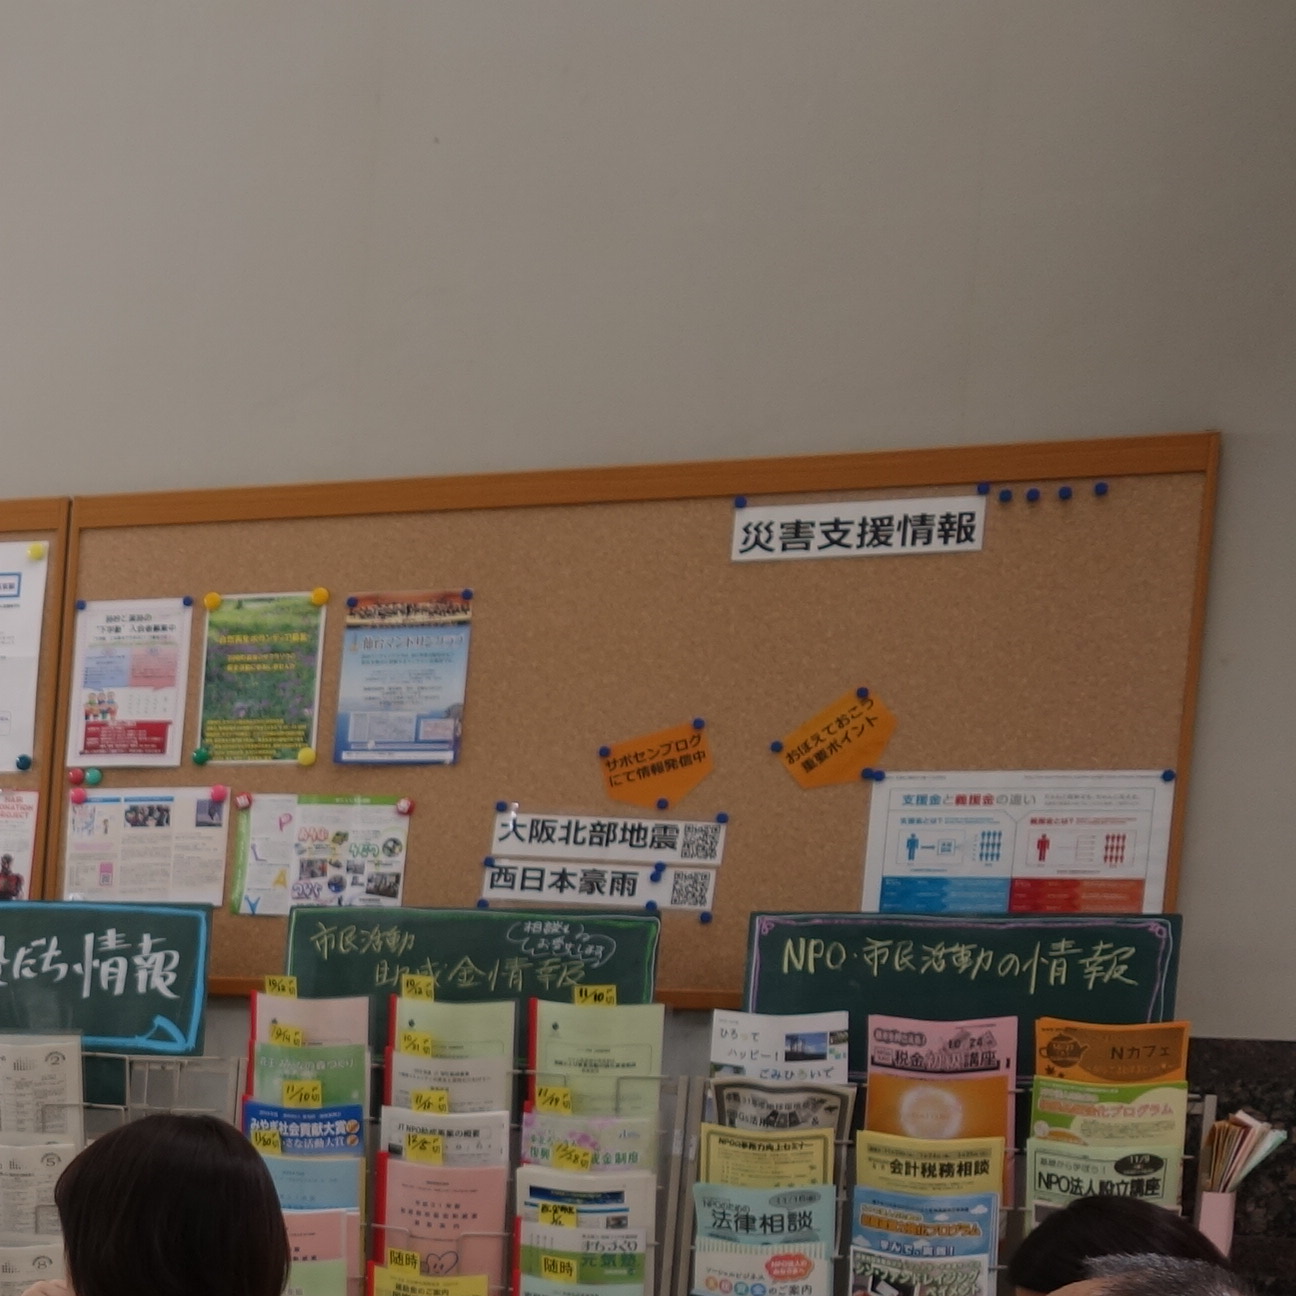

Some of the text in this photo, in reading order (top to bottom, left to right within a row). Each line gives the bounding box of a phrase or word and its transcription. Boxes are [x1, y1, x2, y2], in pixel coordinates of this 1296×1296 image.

[738, 509, 978, 555] 災害支援情報
[785, 698, 876, 766] おぼえておこう
[801, 713, 880, 774] 重要ポイント
[607, 733, 704, 772] サポセンブログ
[608, 750, 707, 788] にて情報発信中
[902, 793, 1037, 806] 支援金と義援金の違い
[498, 817, 680, 852] 大阪北部地震
[488, 864, 639, 898] 西日本豪雨
[311, 920, 416, 960] 市民活動
[781, 936, 1139, 995] NPO・市民活動の情報
[1109, 1044, 1171, 1060] Nカフェ
[889, 1157, 991, 1179] 会計税務相談
[1037, 1170, 1163, 1198] NPO法人設立講座
[711, 1209, 814, 1235] 法律相談
[389, 1251, 419, 1270] 随時
[544, 1257, 574, 1277] 随時
